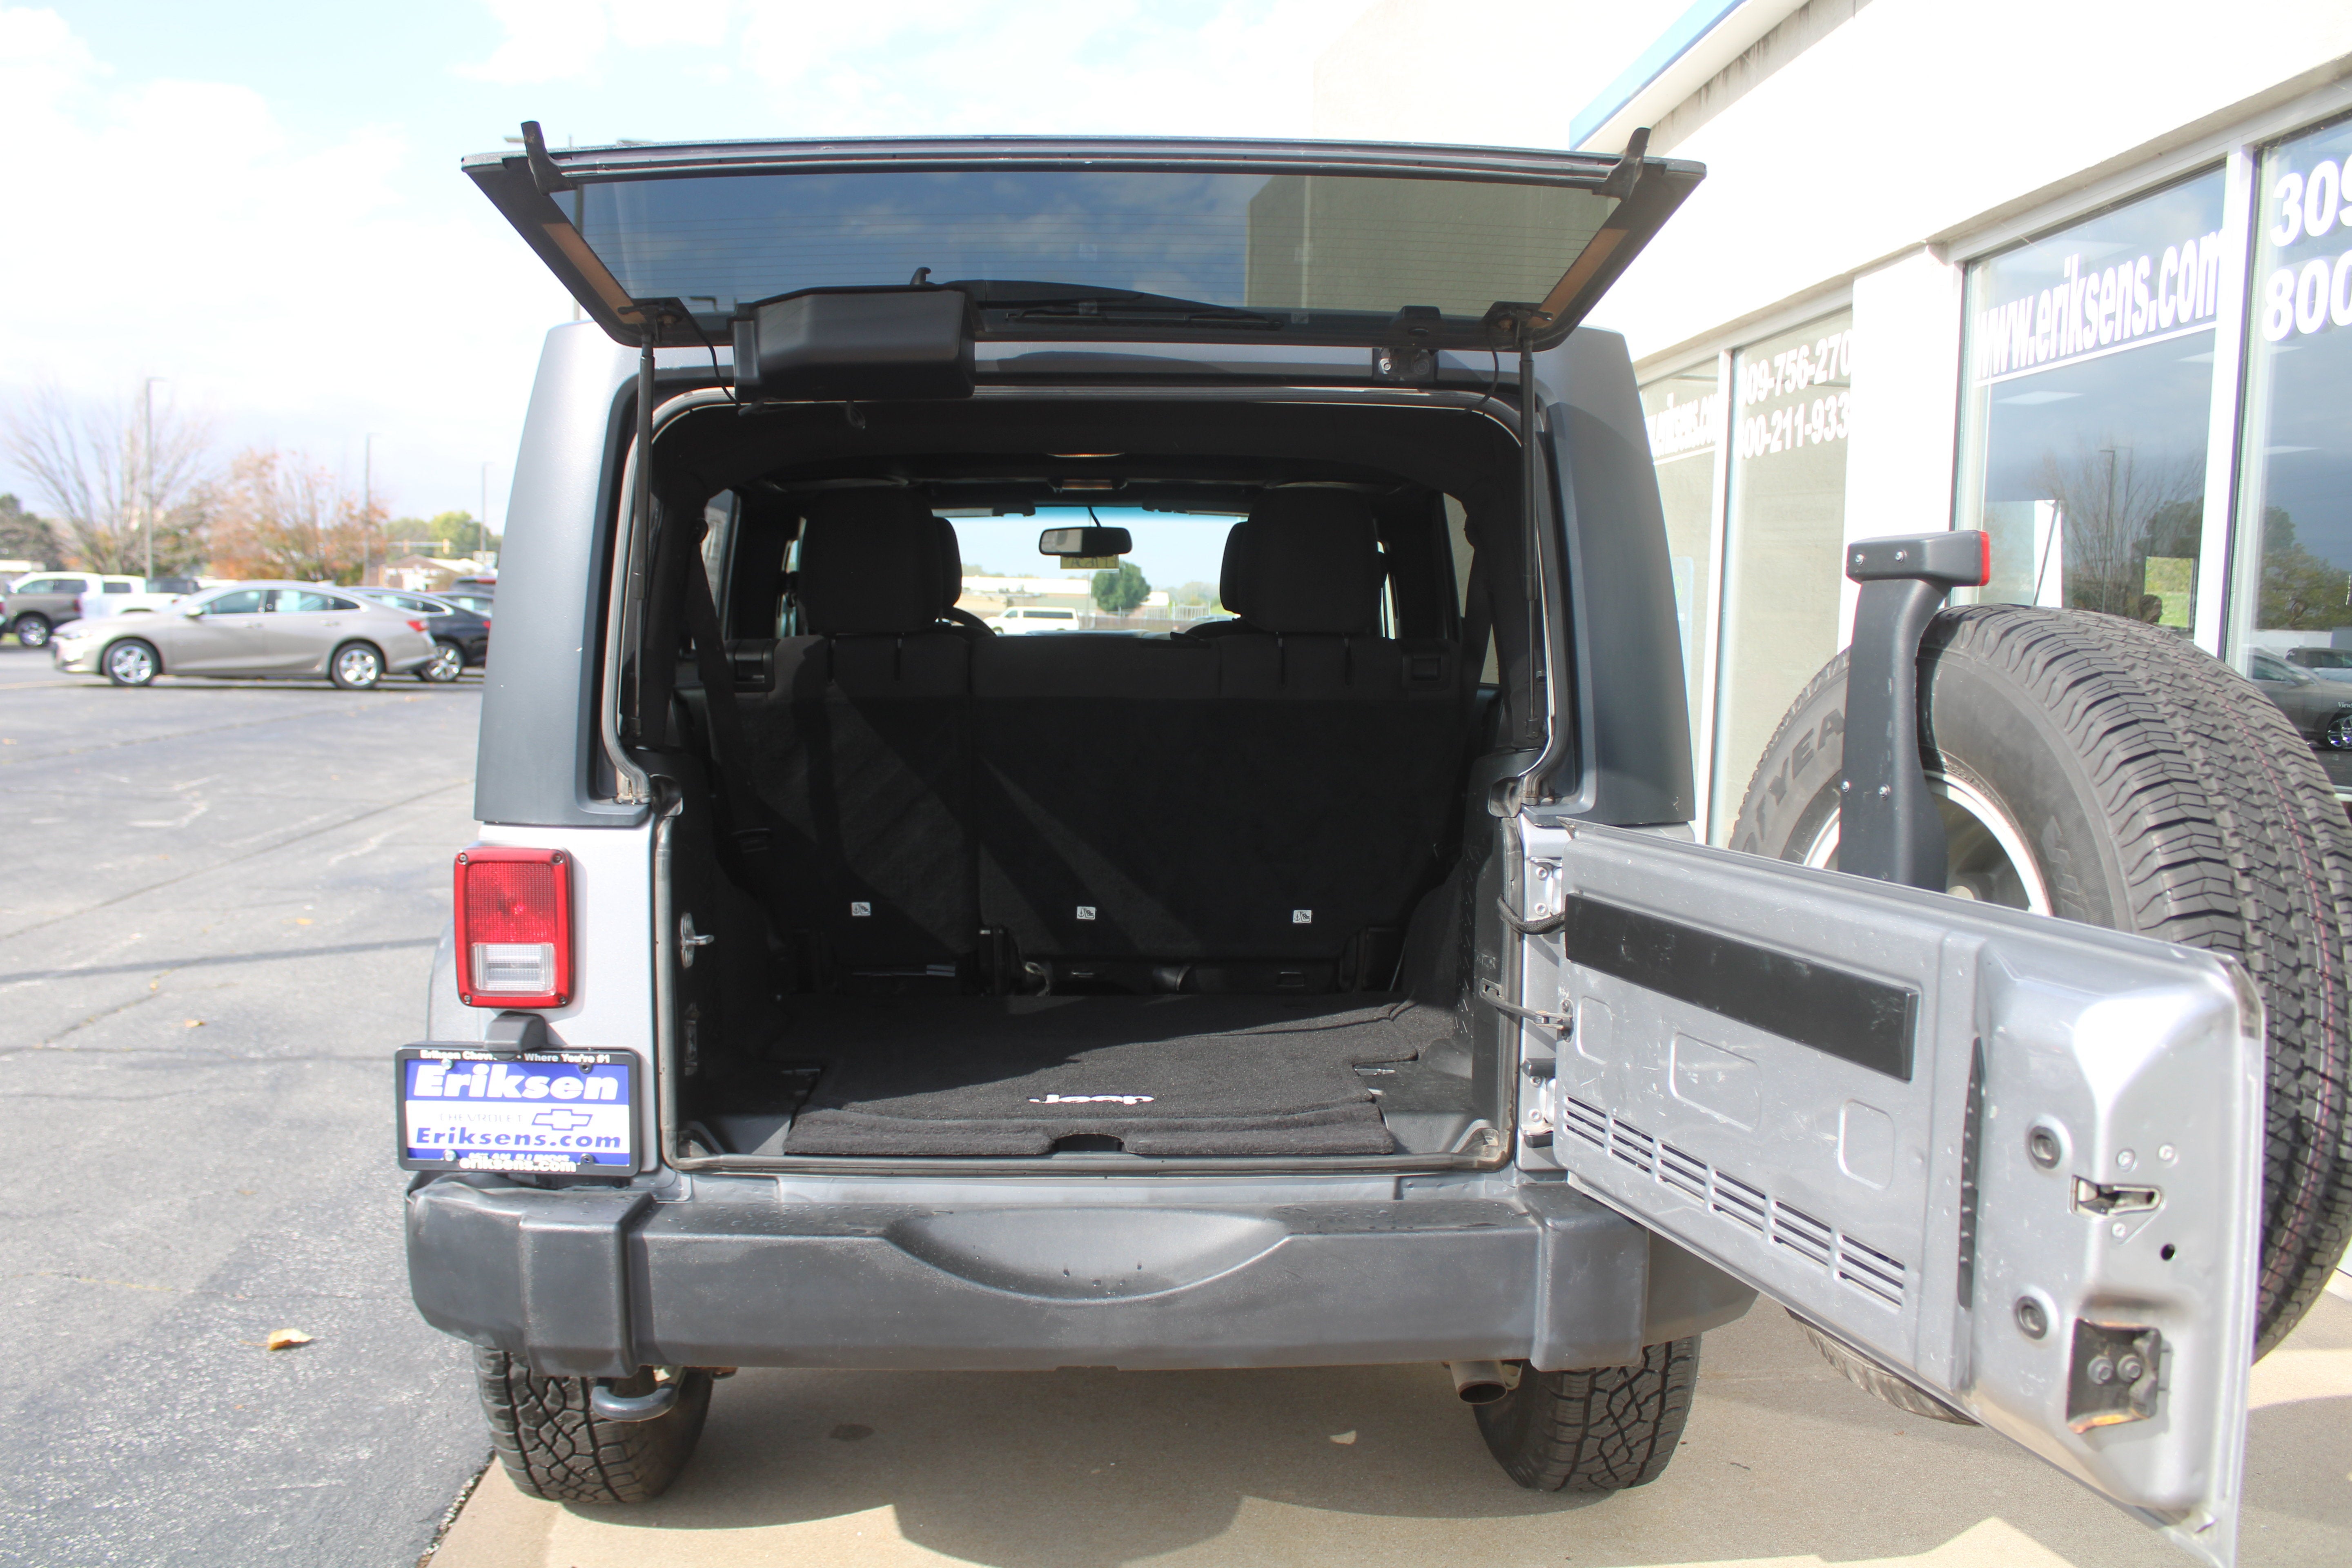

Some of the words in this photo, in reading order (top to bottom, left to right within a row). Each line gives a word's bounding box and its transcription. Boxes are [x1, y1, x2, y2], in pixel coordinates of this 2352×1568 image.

[1974, 228, 2225, 380] www.eriksens.com
[2261, 250, 2352, 342] 800
[420, 1049, 461, 1060] Eriksen
[523, 1053, 559, 1062] Where
[561, 1054, 595, 1063] You're
[597, 1054, 610, 1063] #1
[414, 1063, 618, 1100] Eriksen
[416, 1127, 621, 1148] Eriksens.com
[459, 1155, 577, 1172] eriksens.com
